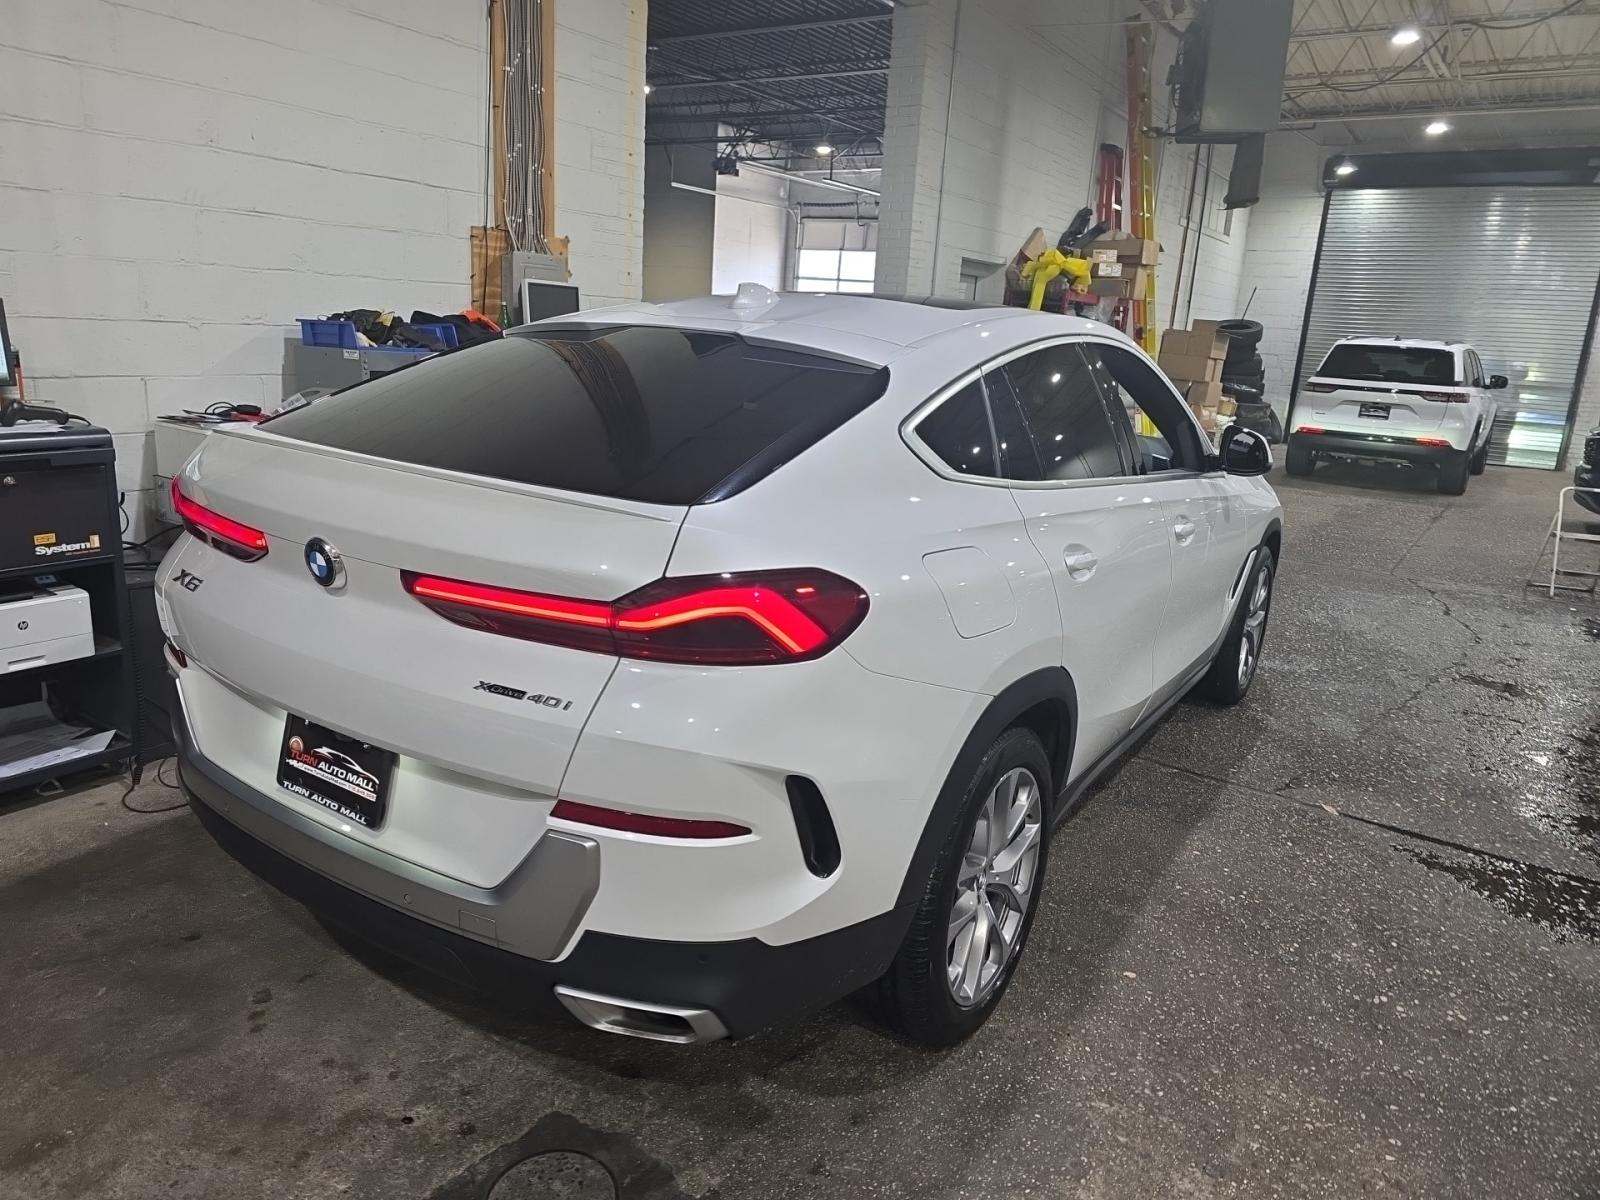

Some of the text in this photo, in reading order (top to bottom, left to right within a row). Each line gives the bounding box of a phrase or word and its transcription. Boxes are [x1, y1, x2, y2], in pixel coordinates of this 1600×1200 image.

[172, 568, 204, 592] X6
[292, 751, 374, 791] TURN AUTO MALL
[283, 781, 366, 824] TURN AUTO MALL
